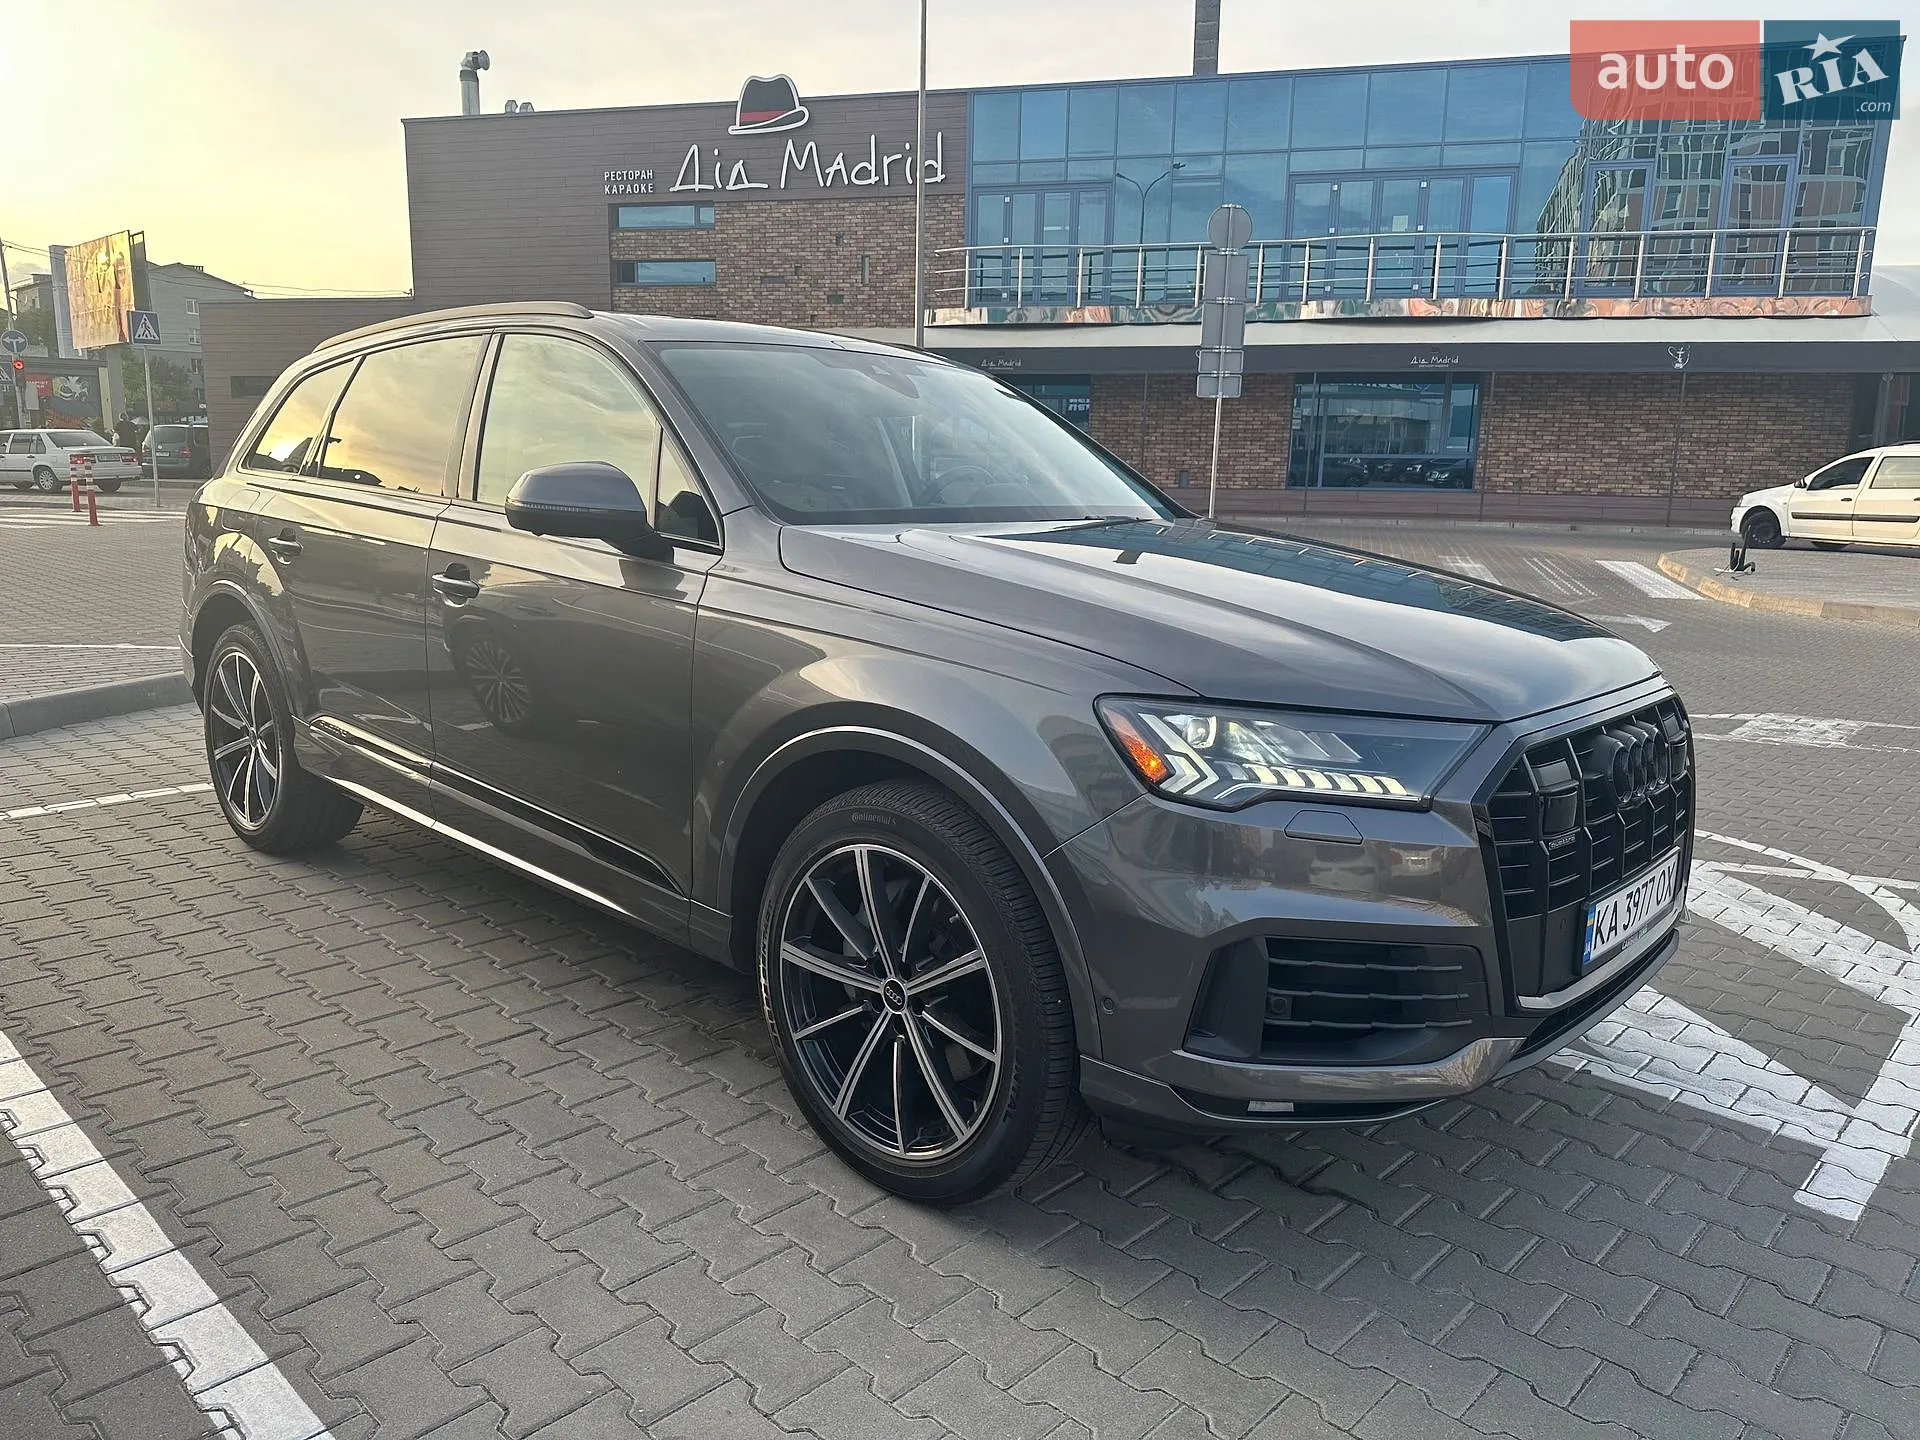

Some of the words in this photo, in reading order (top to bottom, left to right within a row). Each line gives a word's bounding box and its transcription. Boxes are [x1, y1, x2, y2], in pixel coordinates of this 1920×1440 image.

[604, 169, 653, 181] РЕСТОРАН
[604, 183, 654, 195] КАРАОКЕ
[1593, 900, 1618, 950] KA
[1622, 875, 1656, 931] 3977
[1656, 861, 1676, 906] OX
